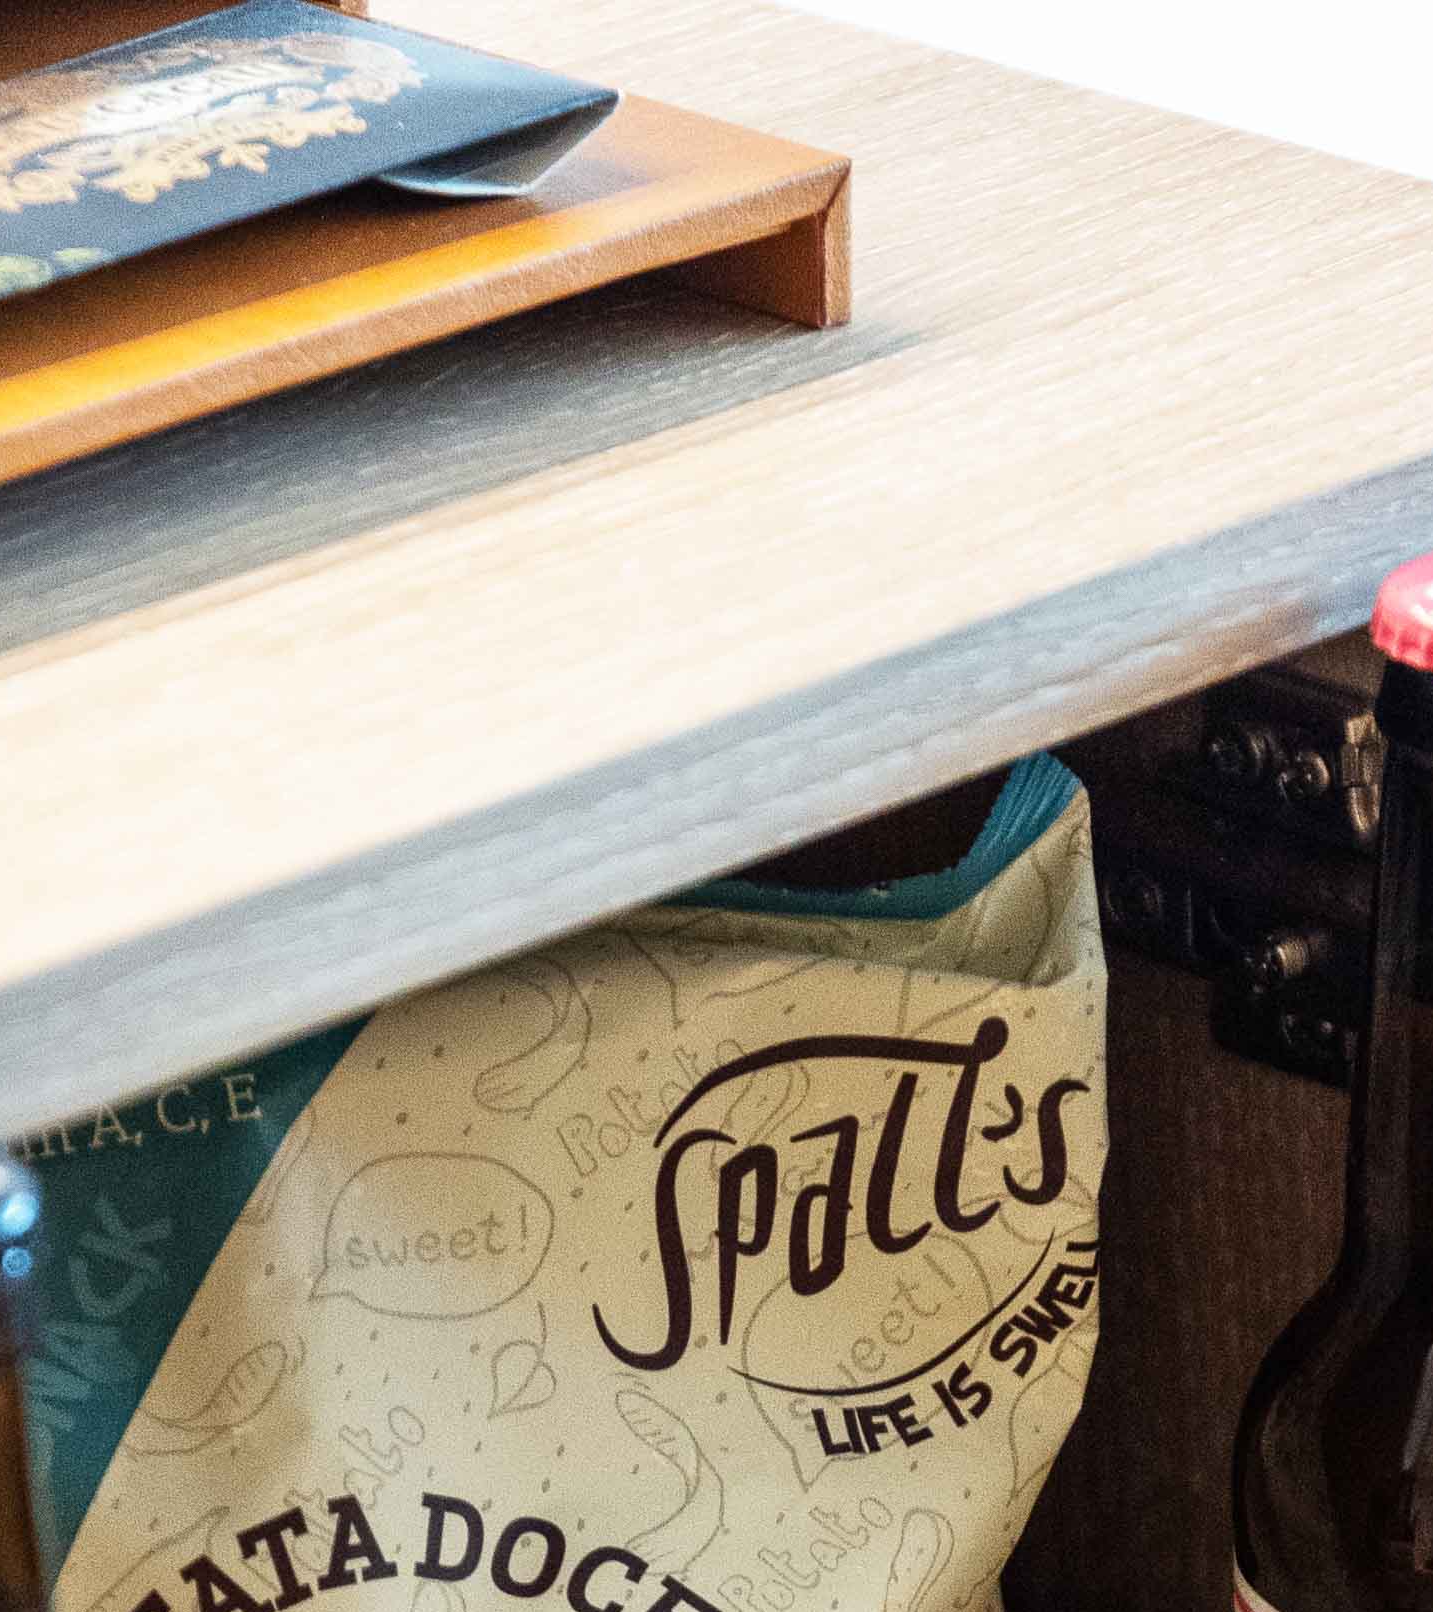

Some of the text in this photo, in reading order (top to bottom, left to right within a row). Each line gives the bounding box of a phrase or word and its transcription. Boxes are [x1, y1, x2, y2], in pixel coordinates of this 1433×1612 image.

[223, 1072, 264, 1121] E
[343, 1201, 530, 1270] sweet!
[811, 1393, 934, 1457] LIFE
[934, 1365, 994, 1428] IS
